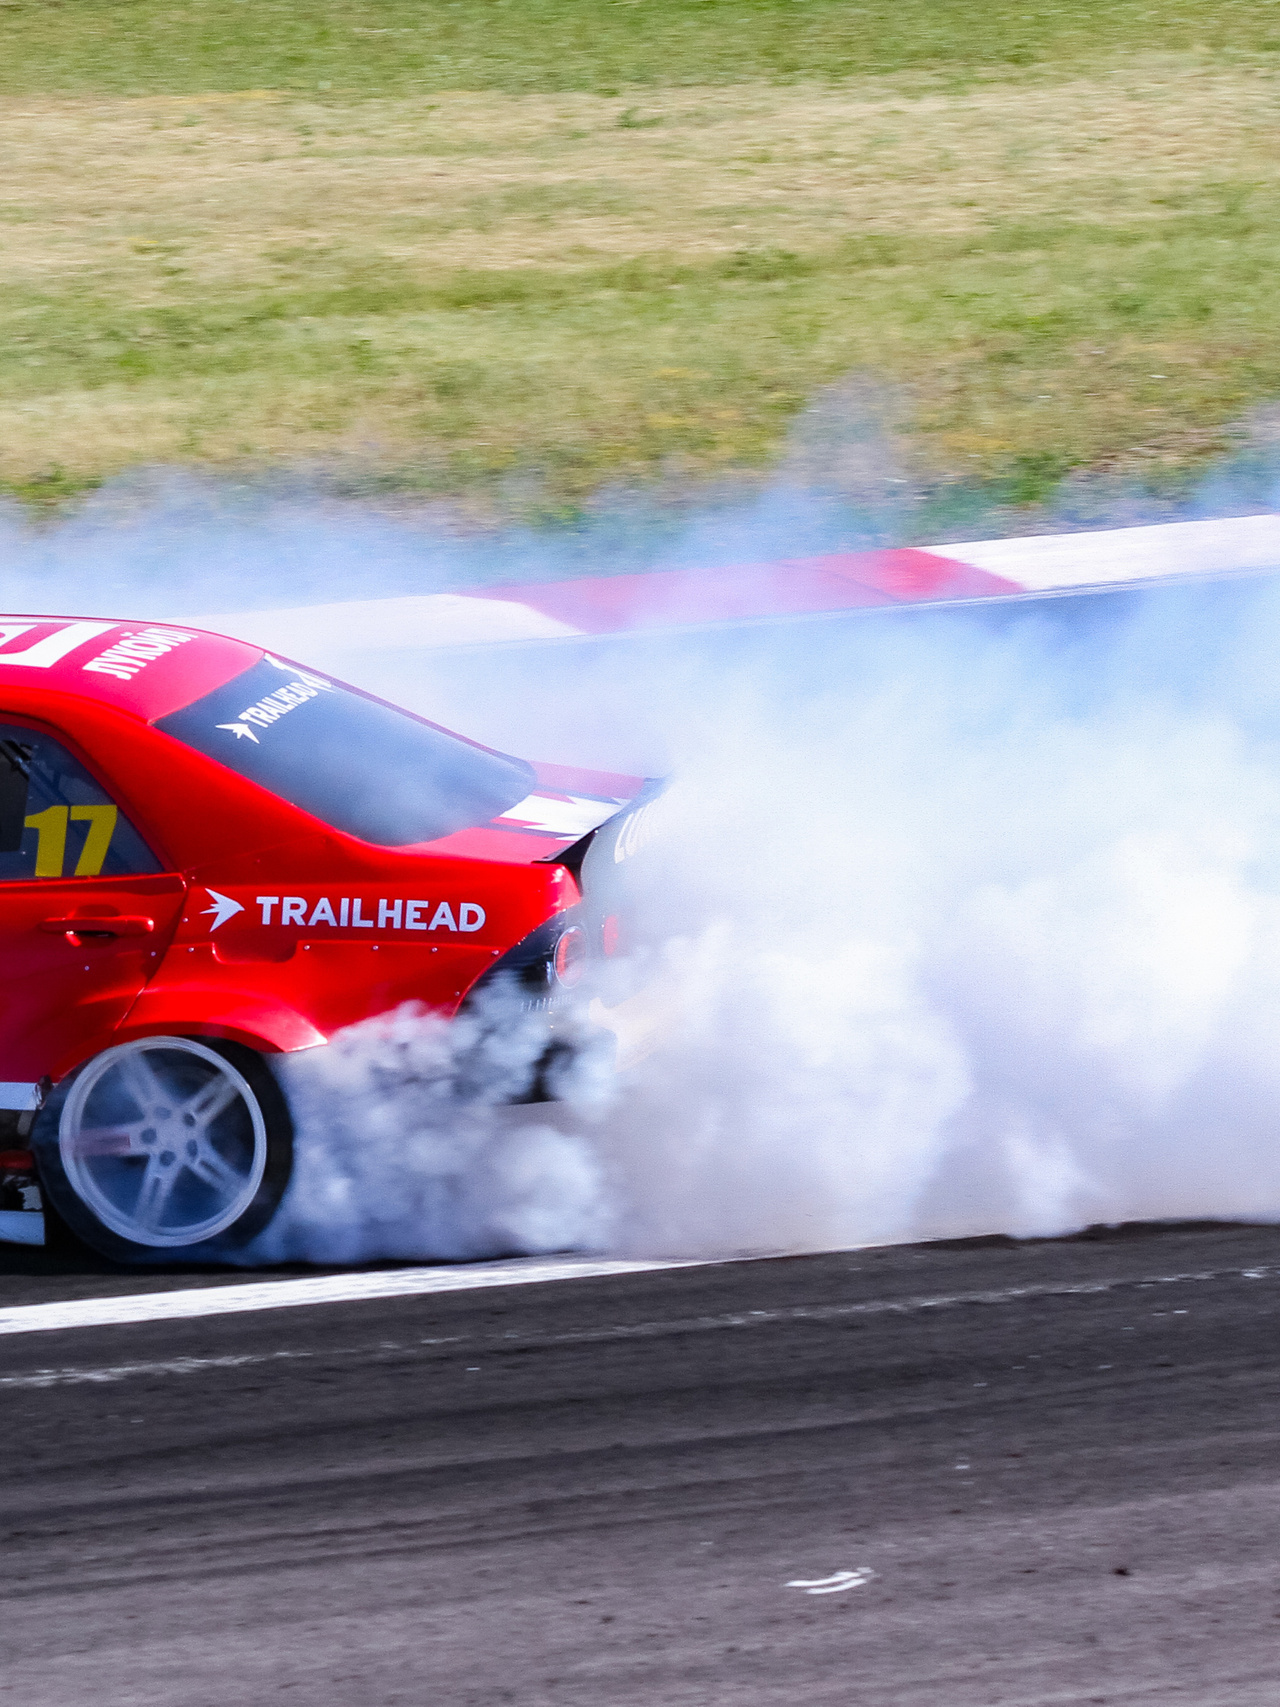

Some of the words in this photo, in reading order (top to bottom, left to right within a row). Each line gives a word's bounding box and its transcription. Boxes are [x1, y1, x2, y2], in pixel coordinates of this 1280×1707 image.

[238, 681, 319, 728] TRAILHEAD
[24, 804, 118, 877] 17
[256, 896, 486, 932] TRAILHEAD
